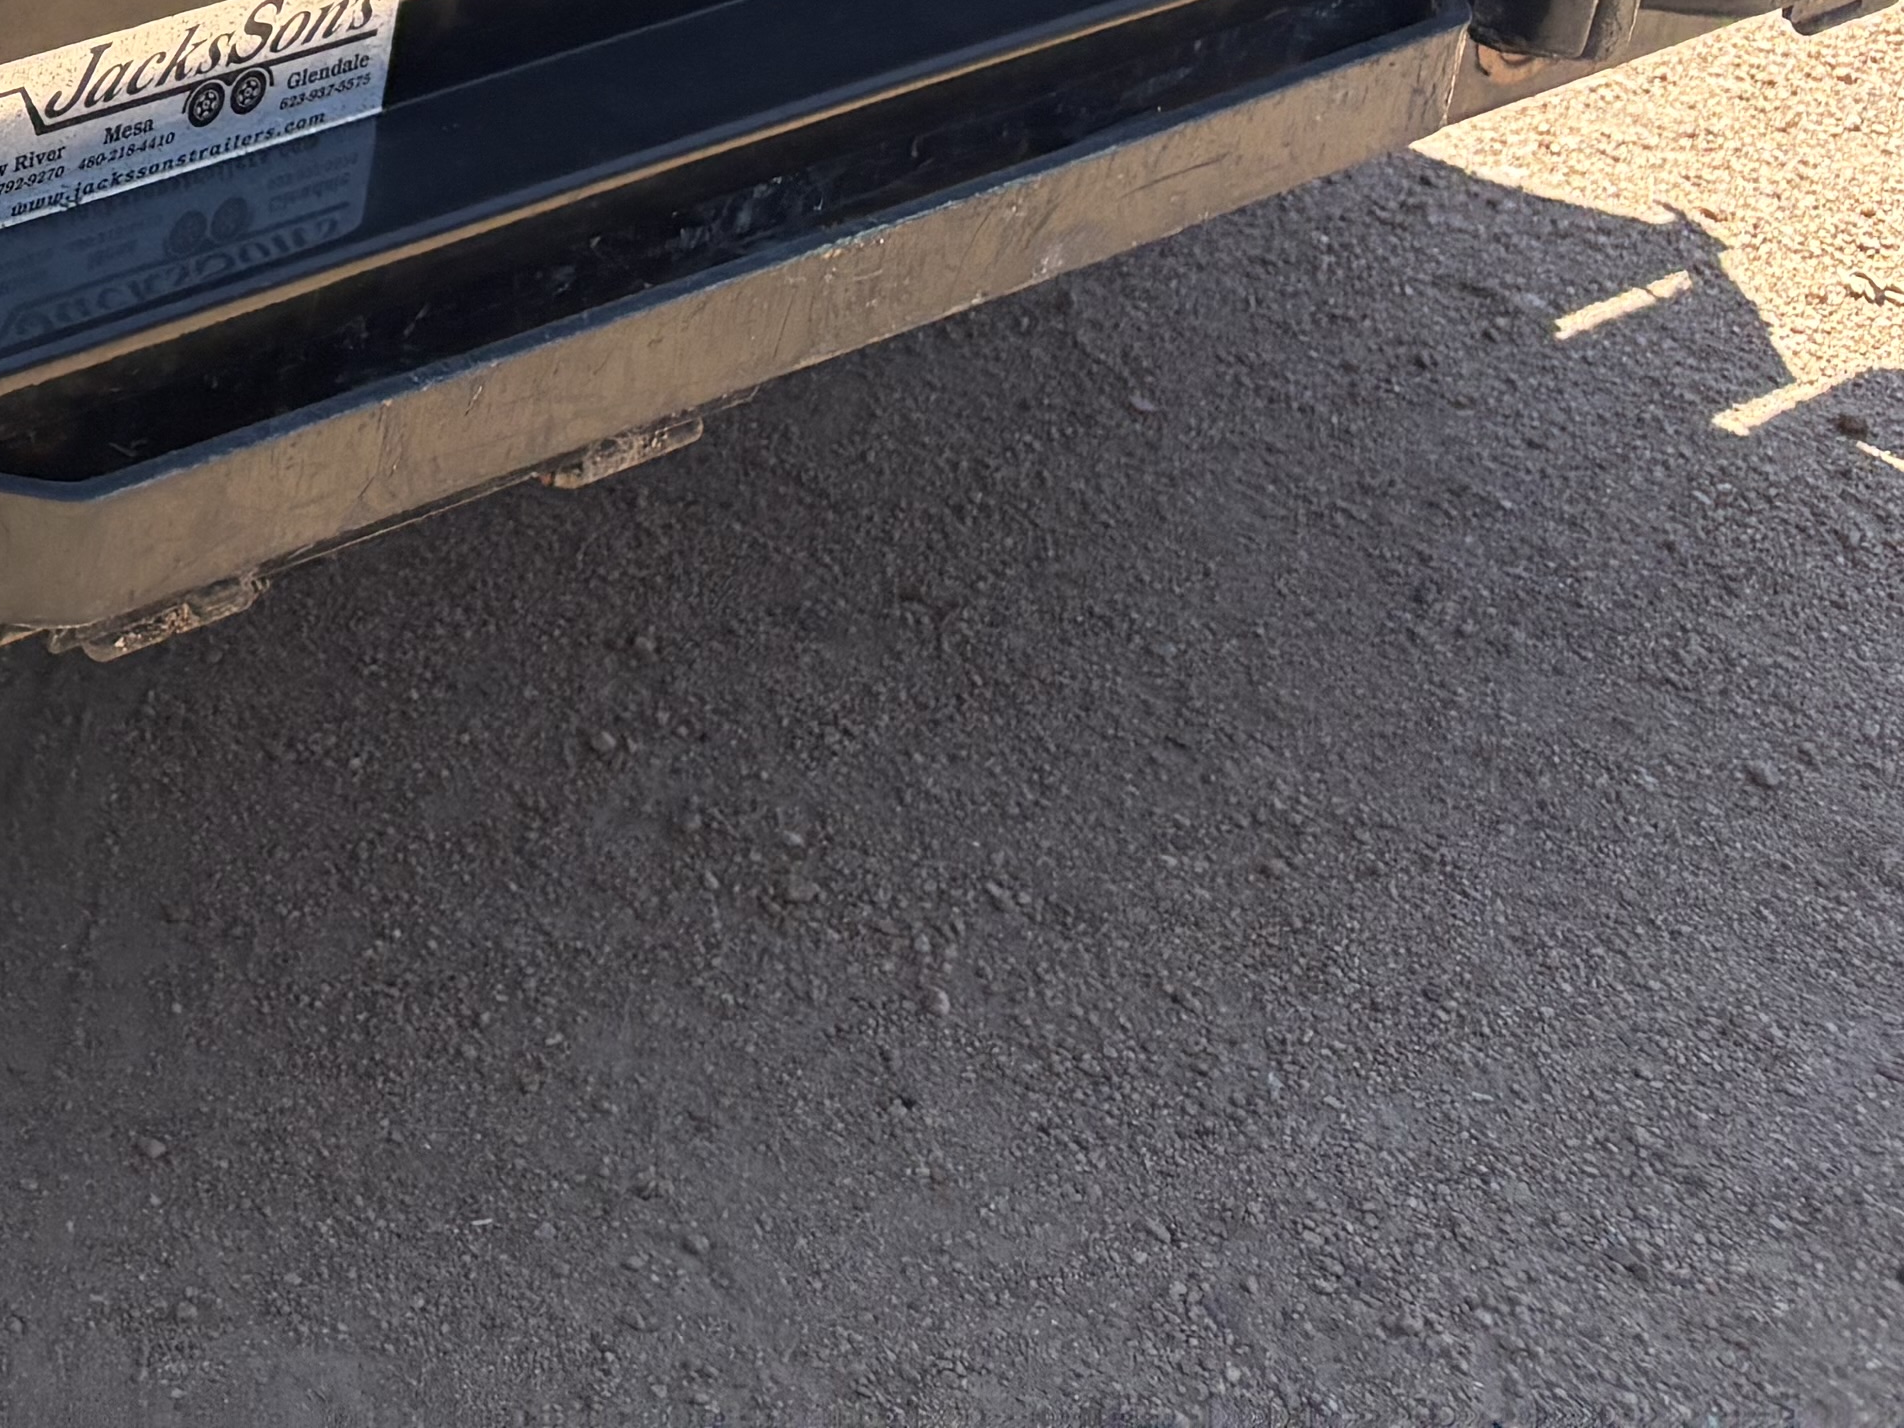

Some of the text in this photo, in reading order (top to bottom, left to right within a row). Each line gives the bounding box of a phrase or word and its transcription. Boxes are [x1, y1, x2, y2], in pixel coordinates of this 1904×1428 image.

[287, 53, 371, 90] Glendale
[279, 72, 372, 111] 623-937-5575
[103, 118, 155, 145] Mesa
[10, 111, 326, 218] www.jackssonstrailers.com
[14, 145, 67, 173] River
[78, 131, 176, 171] 480-218-4410
